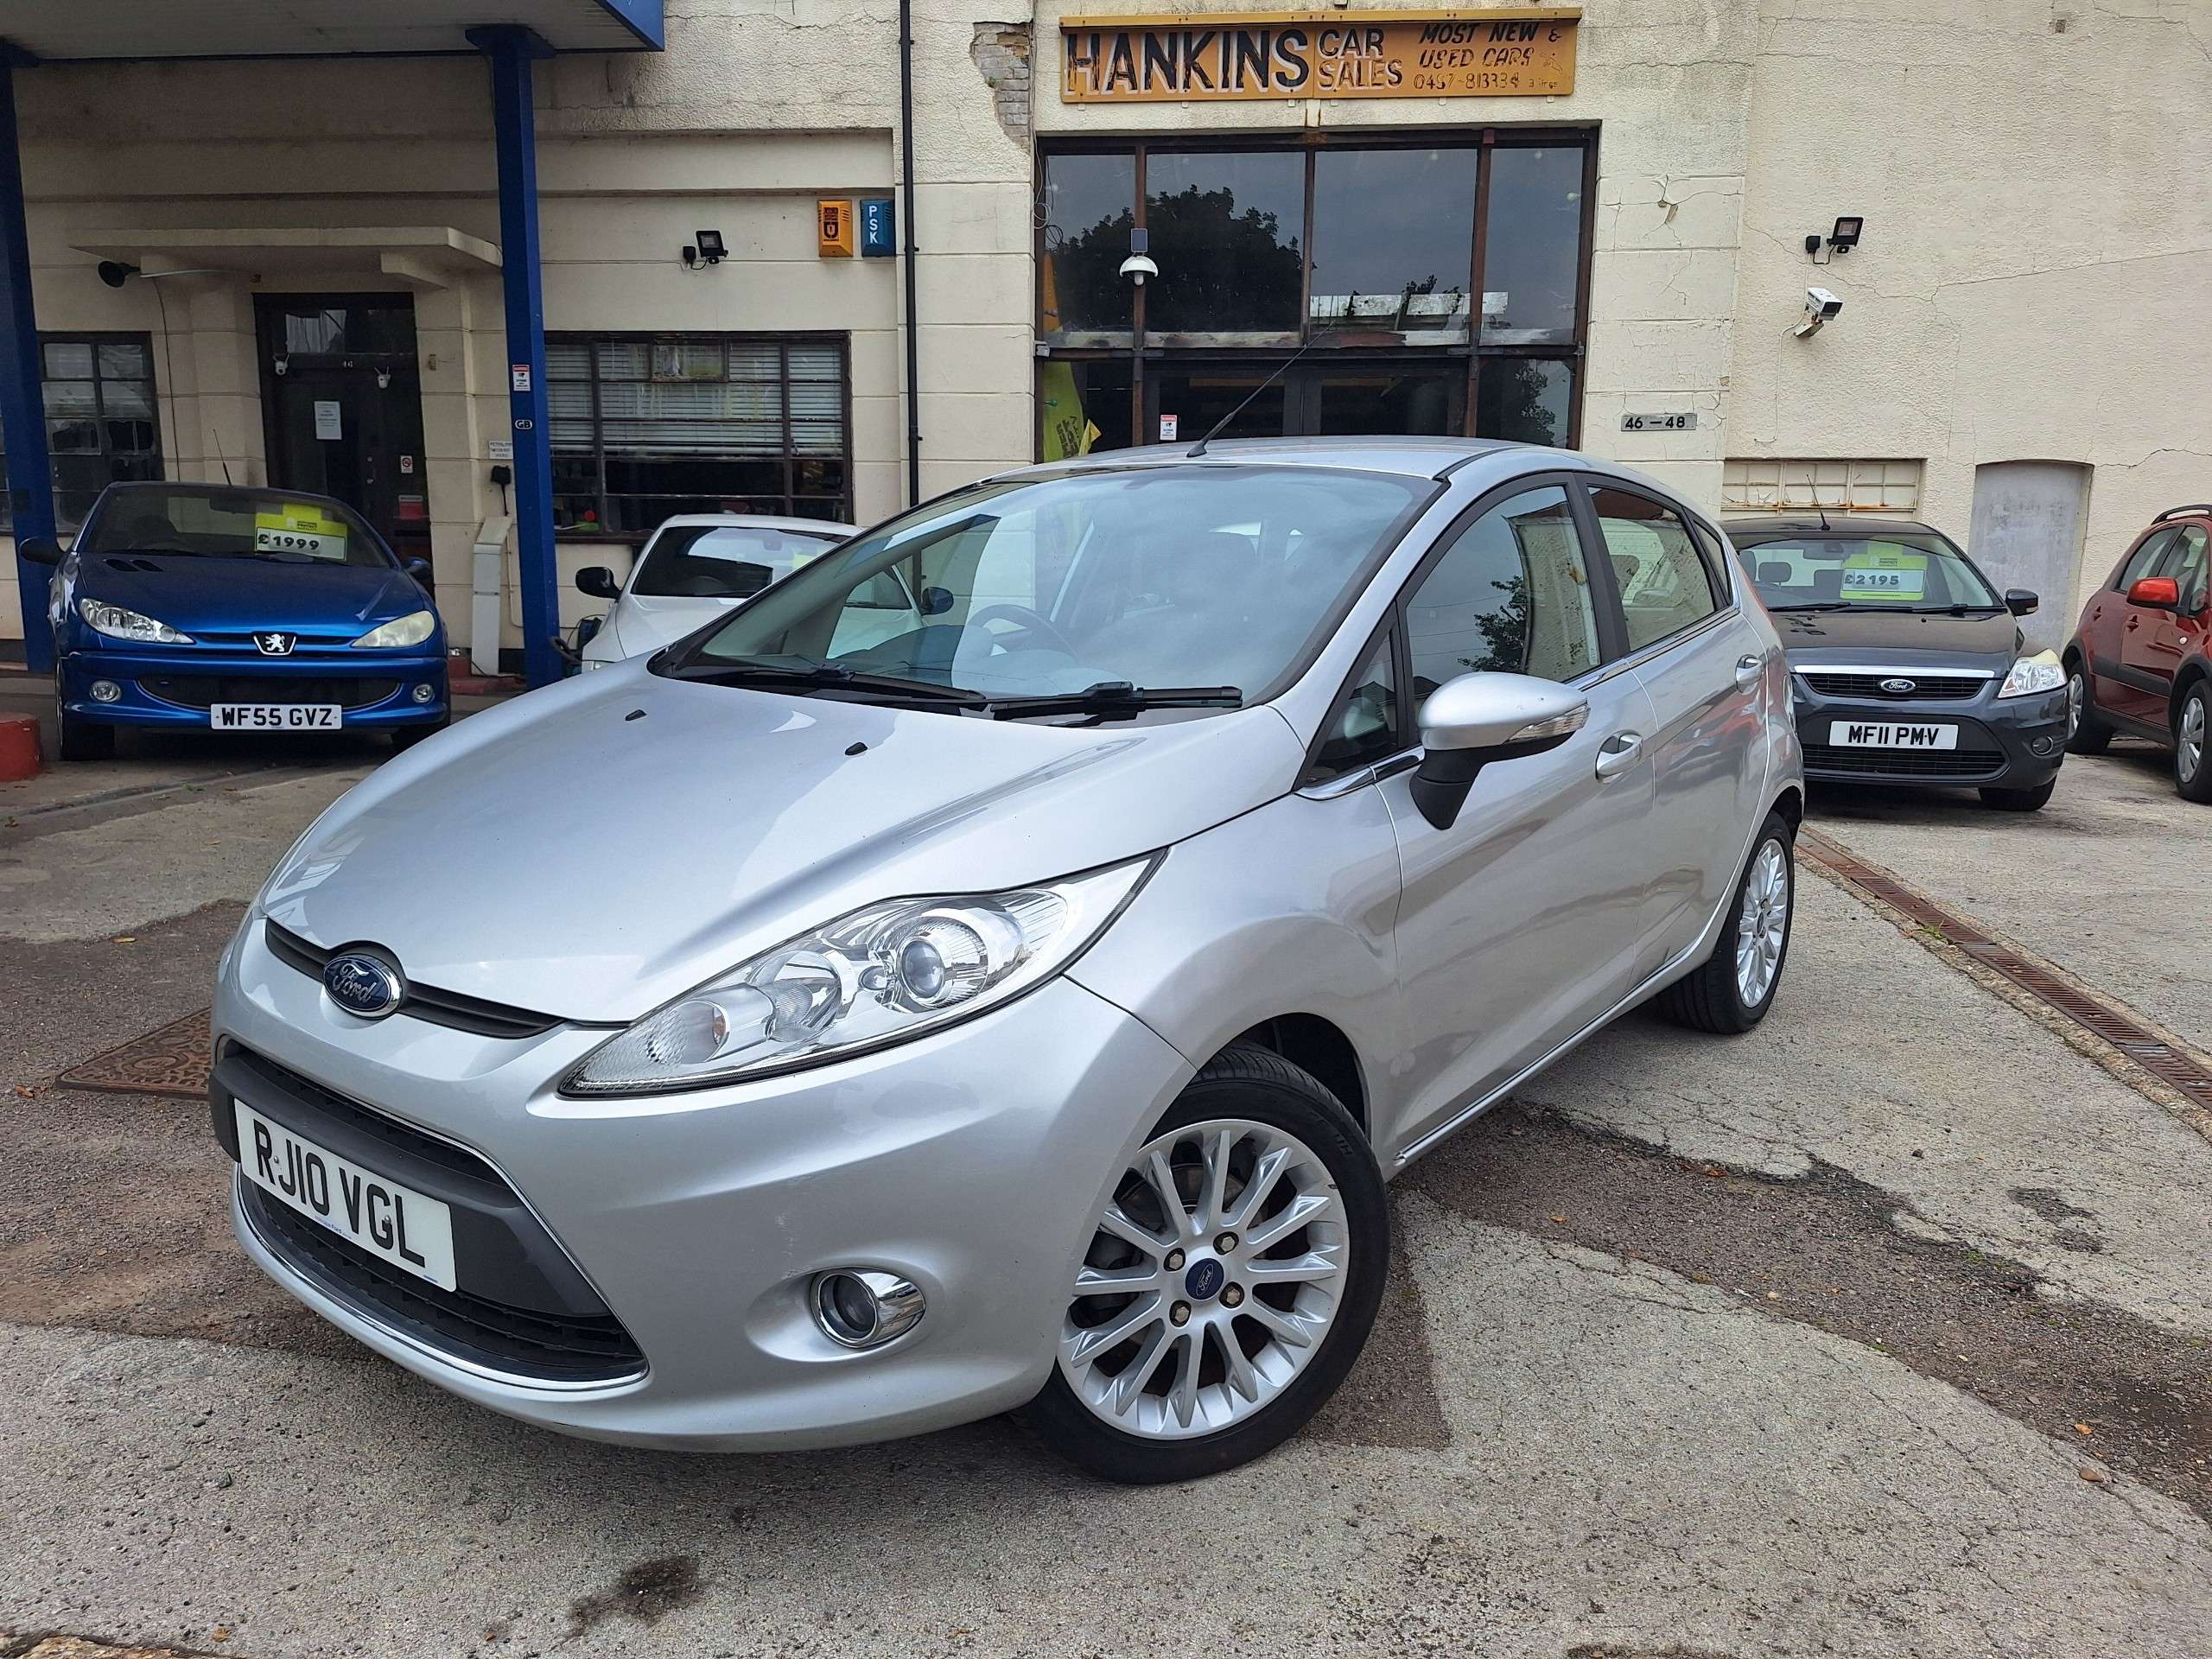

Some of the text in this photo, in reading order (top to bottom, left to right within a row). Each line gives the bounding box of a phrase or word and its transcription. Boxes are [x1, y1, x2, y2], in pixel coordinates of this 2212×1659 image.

[1319, 29, 1385, 58] CAR
[1420, 22, 1562, 43] MOST NEW &
[1065, 29, 1310, 93] HANKINS
[1419, 47, 1535, 69] USED CARS
[1318, 60, 1404, 89] SALES
[868, 206, 879, 244] PSK
[517, 420, 531, 429] GB
[1625, 416, 1643, 429] 46
[1665, 416, 1685, 429] 48
[257, 533, 320, 550] £1999
[1844, 574, 1899, 586] £2195
[1888, 681, 1909, 690] Ford
[221, 707, 333, 727] WF55 GVZ
[1847, 725, 1939, 747] MF11 PMV
[332, 963, 378, 1003] Ford
[252, 1117, 426, 1268] RJ10 VGL
[1198, 1269, 1213, 1292] Ford
